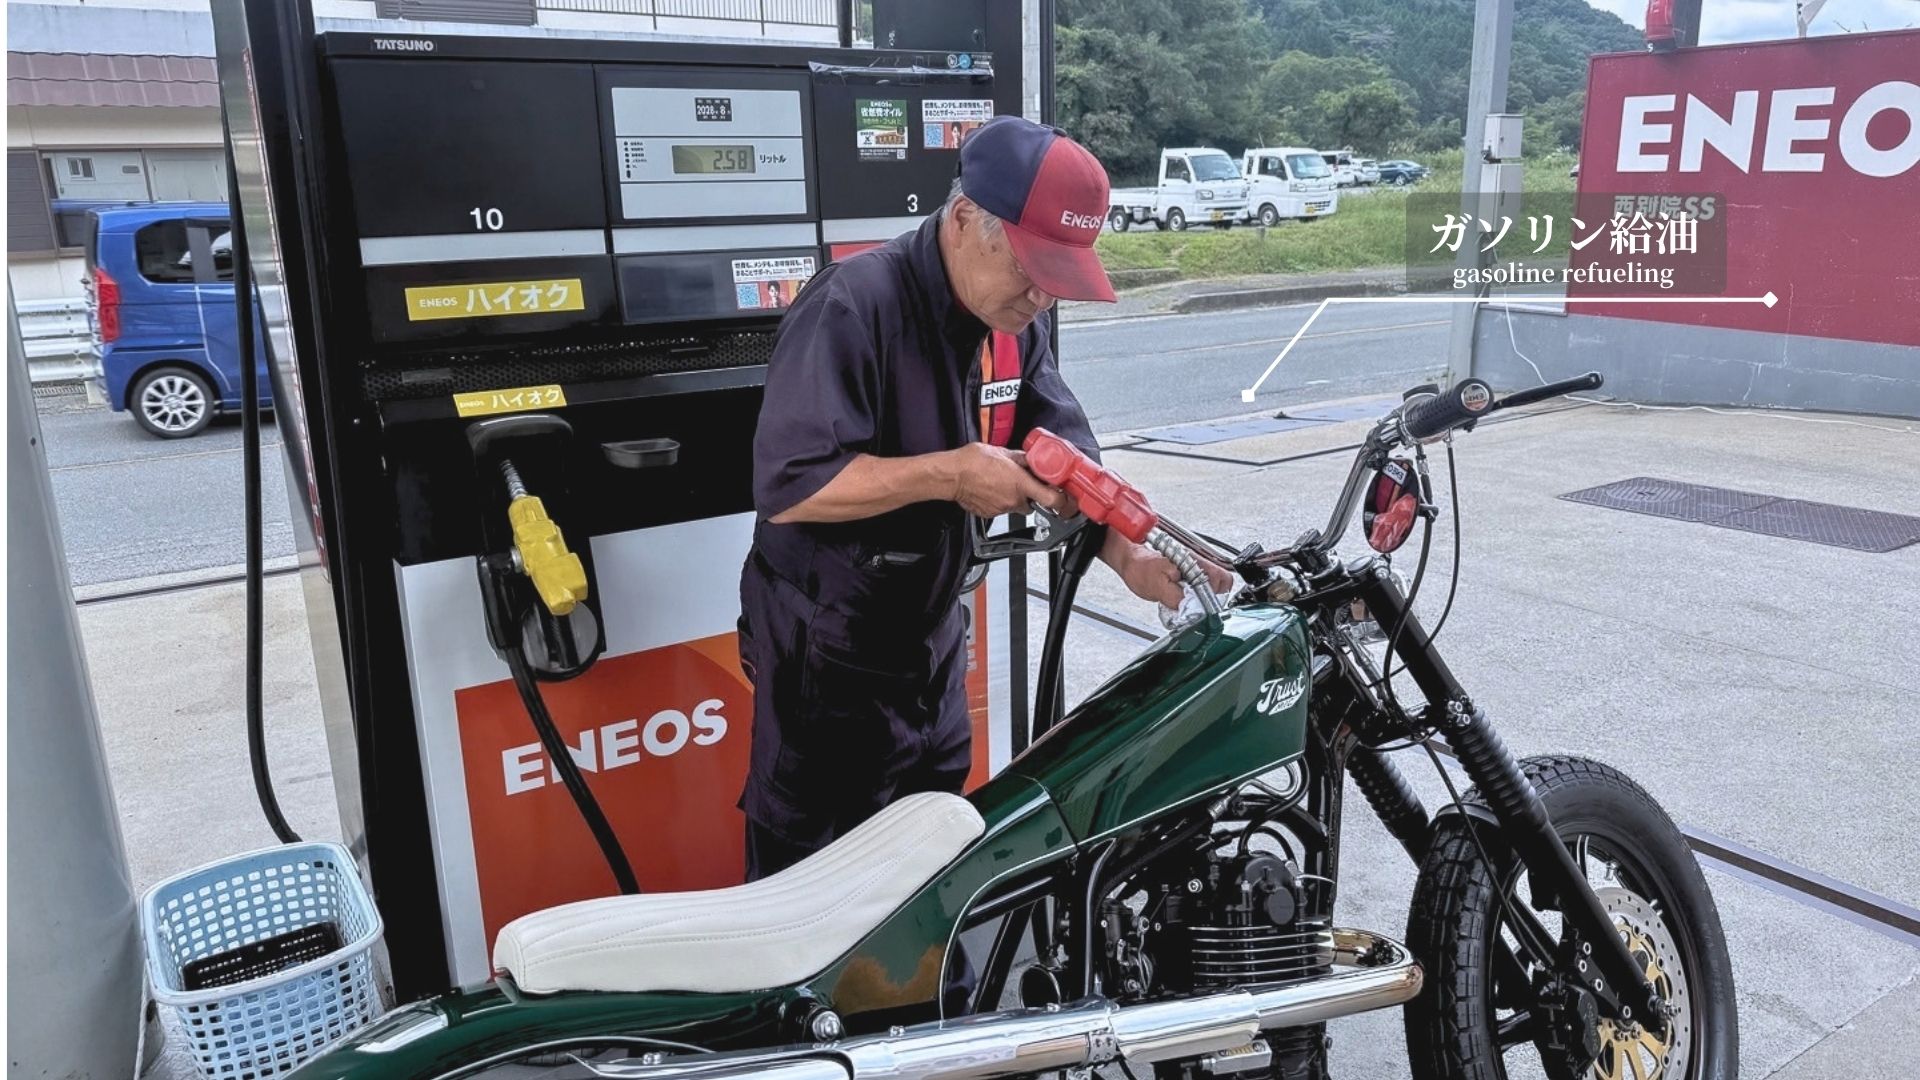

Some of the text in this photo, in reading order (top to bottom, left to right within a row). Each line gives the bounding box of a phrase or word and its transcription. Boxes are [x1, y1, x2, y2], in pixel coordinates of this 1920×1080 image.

[373, 39, 434, 51] TATSUNO
[1616, 80, 1920, 178] ENEO
[759, 154, 787, 164] リットル
[907, 193, 919, 213] 3
[470, 207, 504, 231] 10
[1060, 210, 1102, 230] ENEOS
[419, 283, 569, 313] ENEOS ハイオク
[492, 388, 560, 409] ハイオク
[985, 384, 1020, 400] ENEOS
[502, 698, 728, 796] ENEOS
